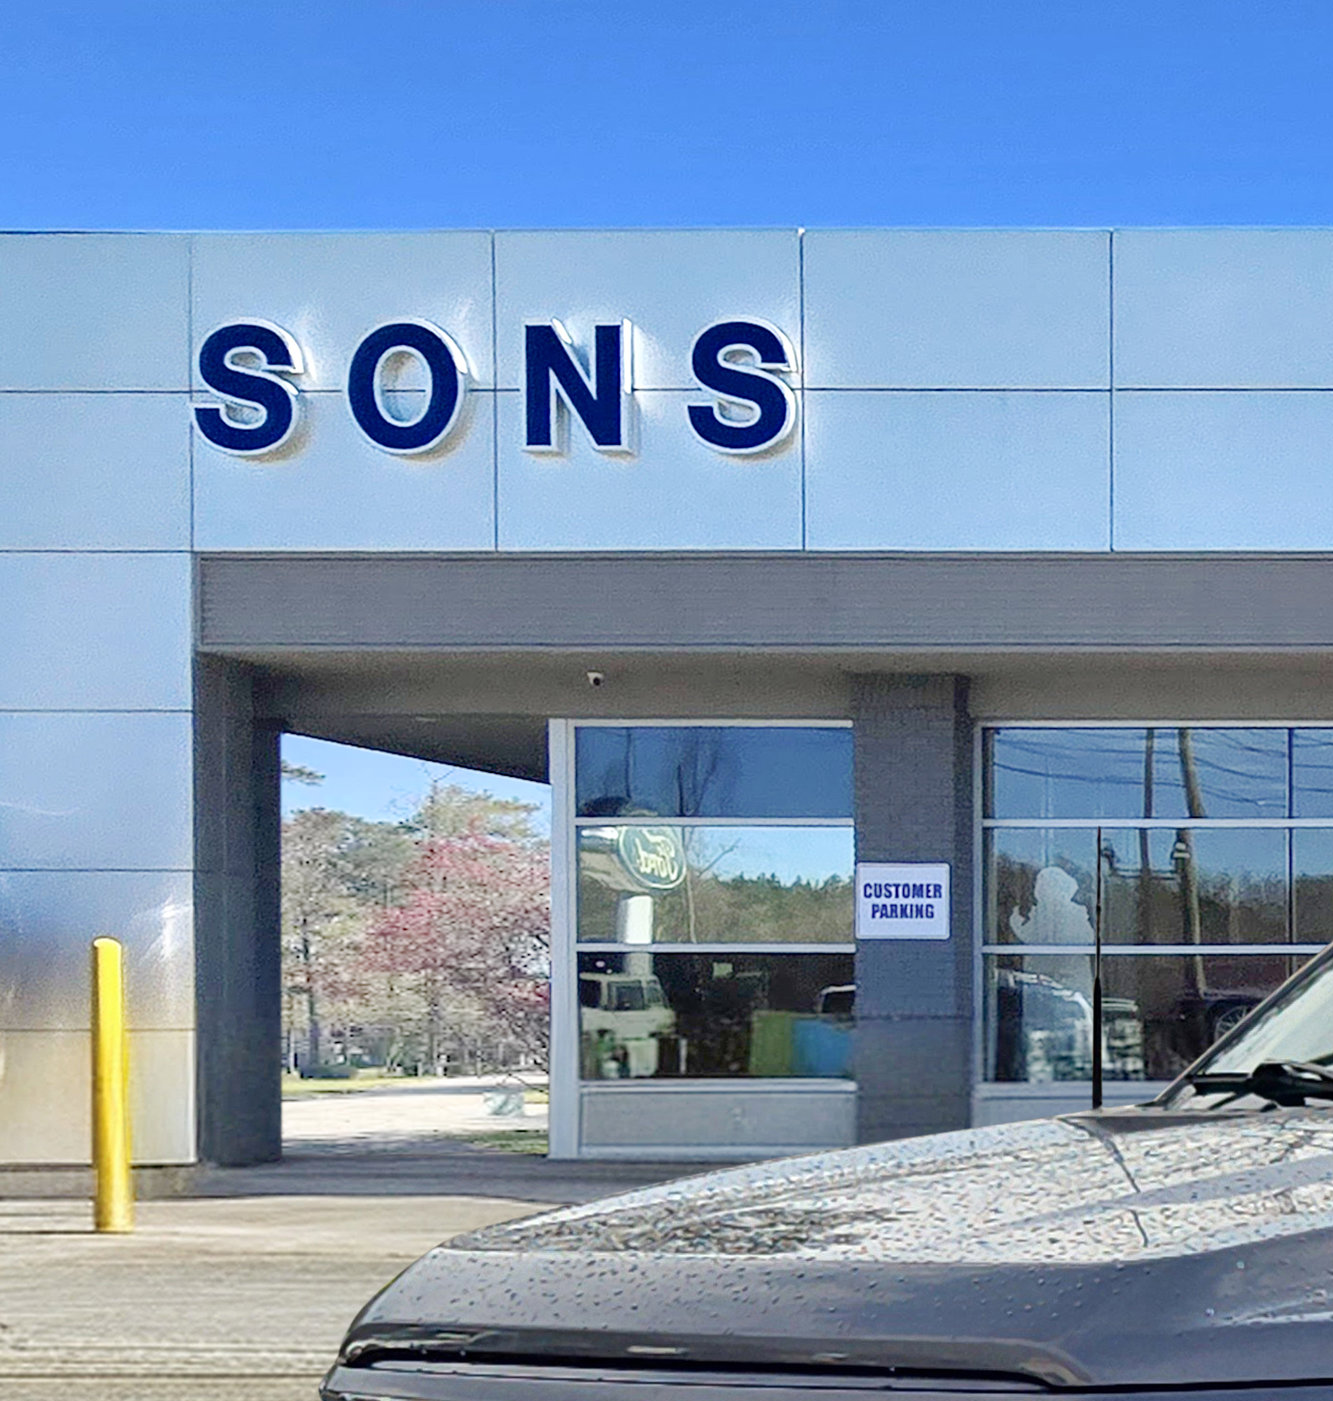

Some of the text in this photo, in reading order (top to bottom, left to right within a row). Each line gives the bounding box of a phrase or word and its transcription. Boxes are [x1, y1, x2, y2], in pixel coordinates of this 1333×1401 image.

[193, 320, 799, 454] SONS
[863, 883, 942, 898] CUSTOMER
[871, 903, 935, 919] PARKING
